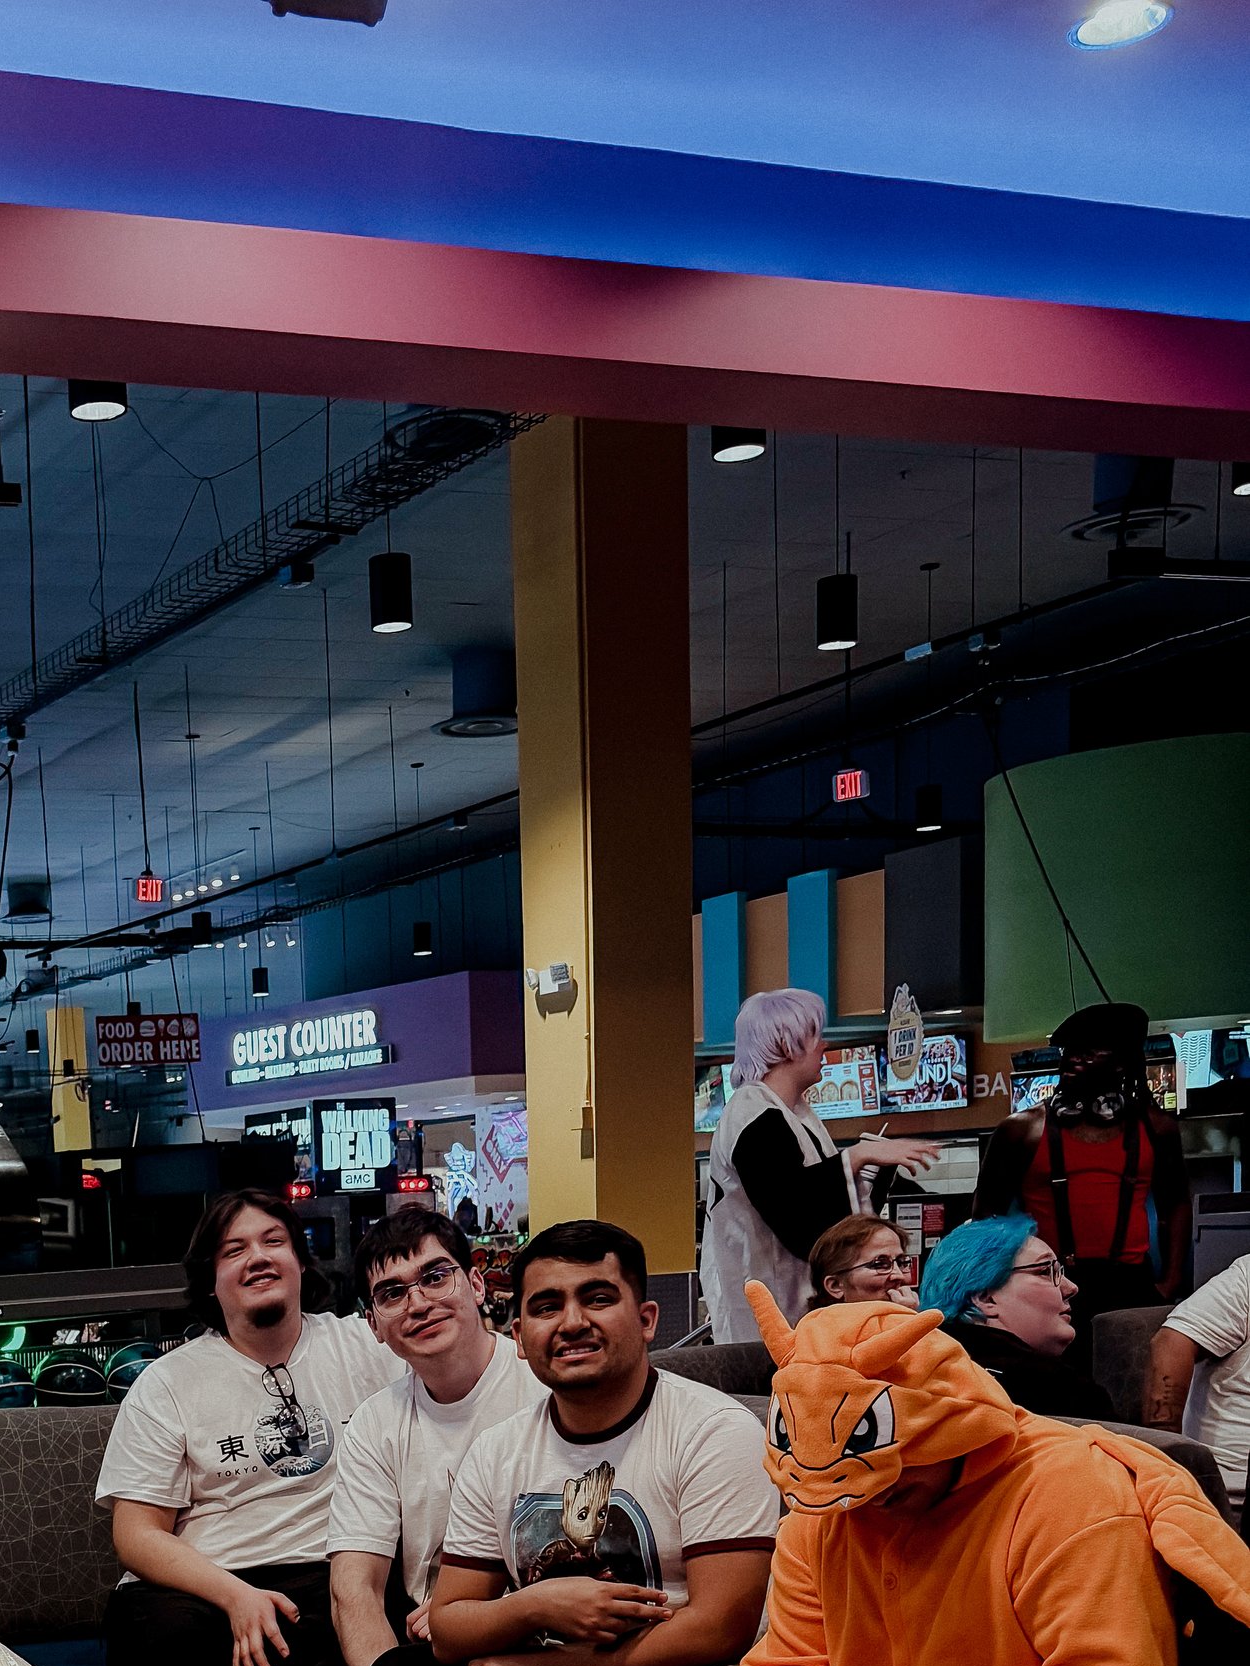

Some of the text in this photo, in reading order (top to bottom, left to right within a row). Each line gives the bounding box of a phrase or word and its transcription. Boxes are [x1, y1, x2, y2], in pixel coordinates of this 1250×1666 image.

[837, 771, 862, 800] EXIT
[138, 879, 162, 902] EXIT
[98, 1022, 135, 1039] FOOD
[232, 1010, 377, 1066] GUEST COUNTER
[98, 1039, 200, 1062] ORDER HERE
[321, 1108, 390, 1133] WALKING
[322, 1131, 391, 1171] DEAD
[217, 1465, 258, 1478] TOKYO
